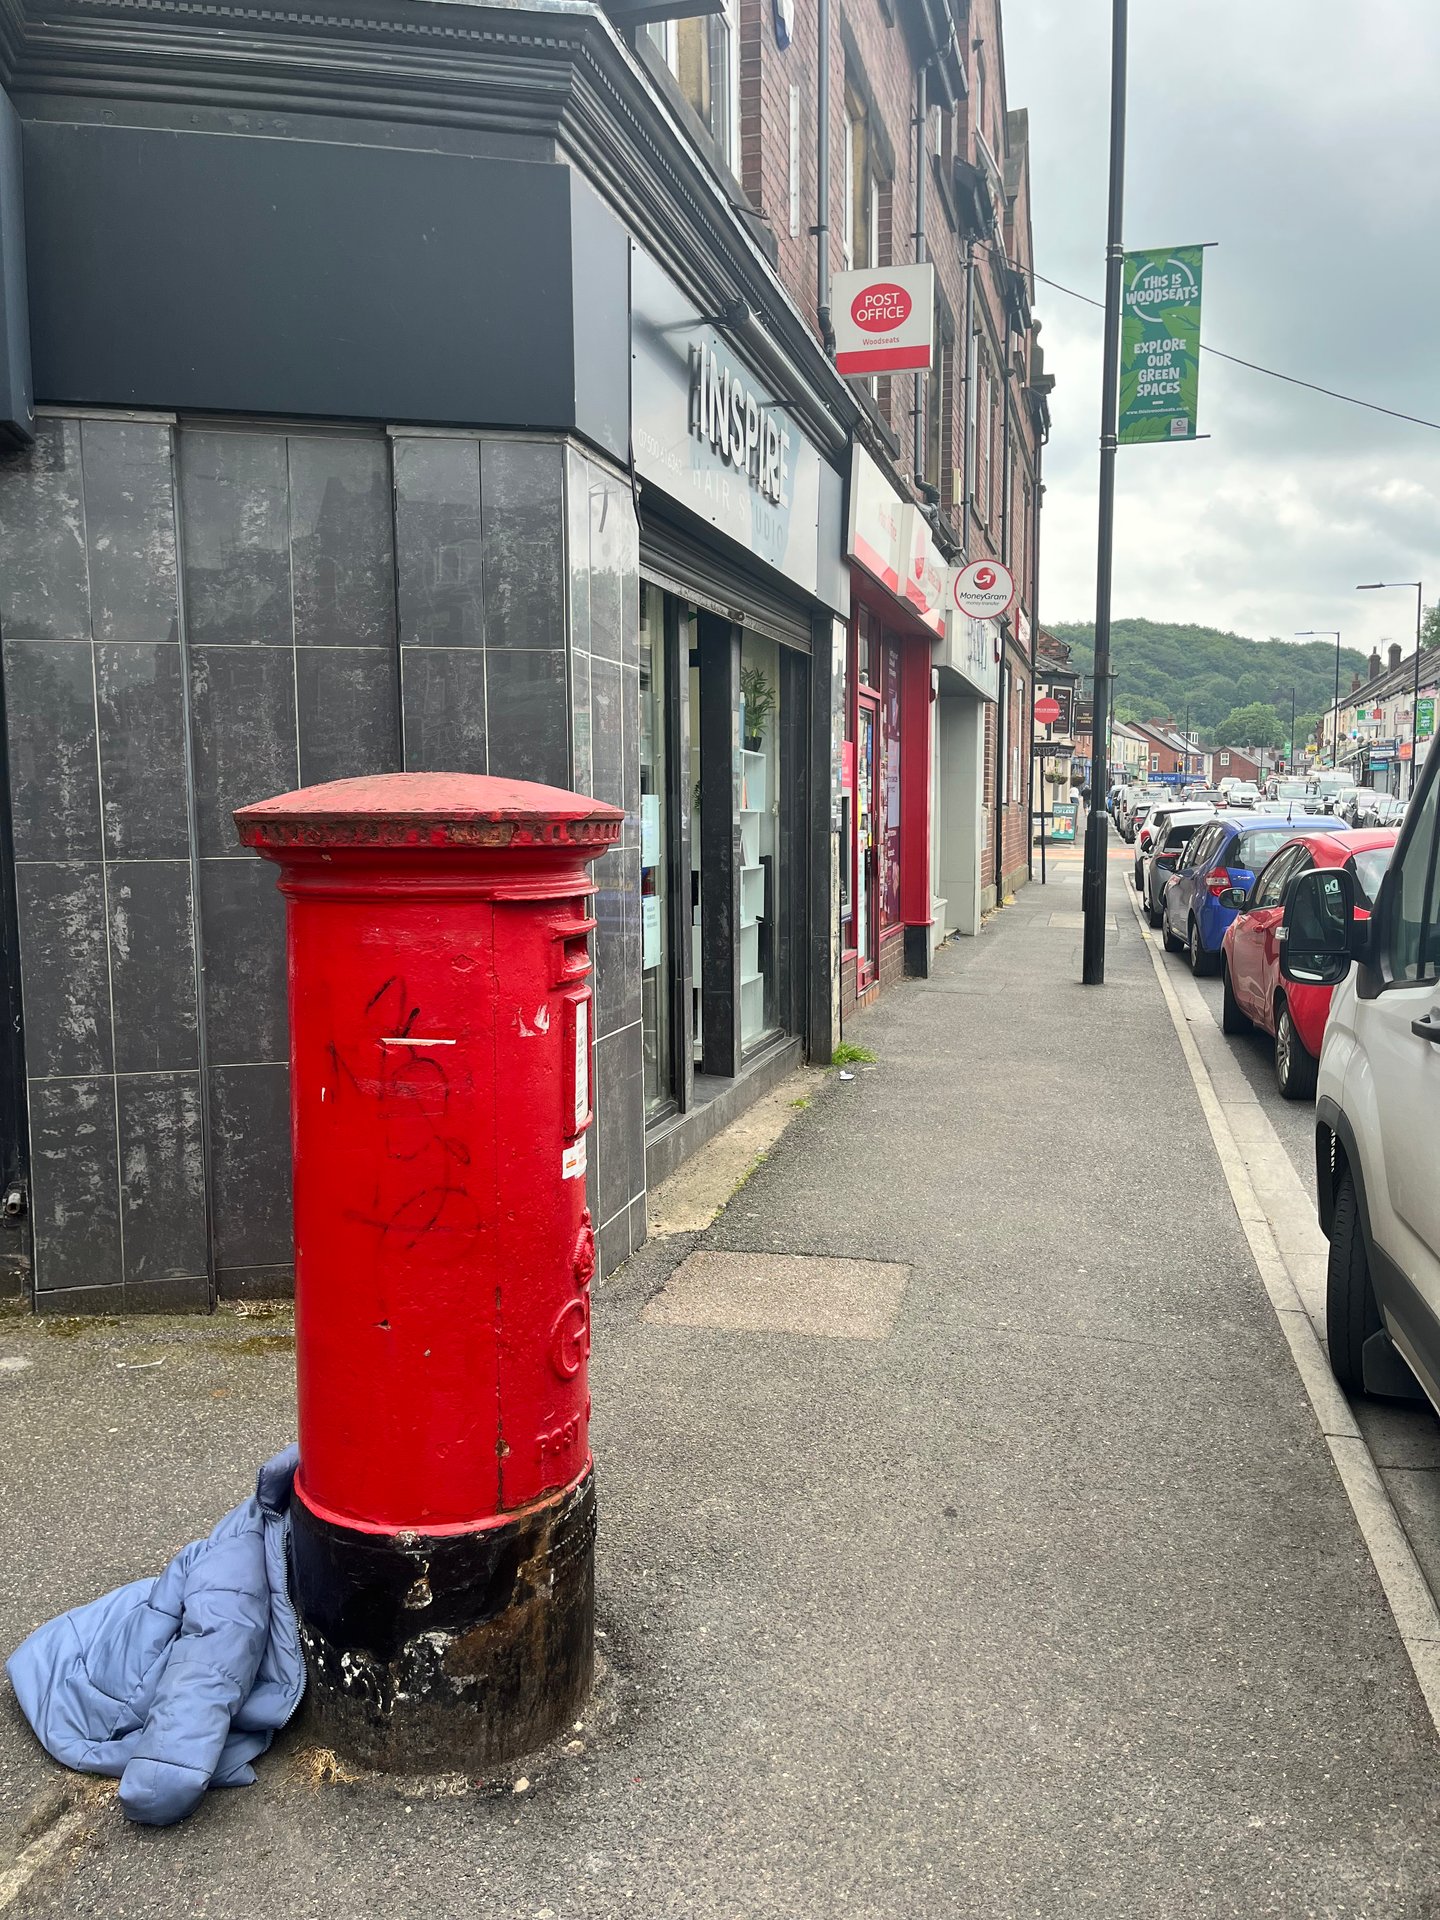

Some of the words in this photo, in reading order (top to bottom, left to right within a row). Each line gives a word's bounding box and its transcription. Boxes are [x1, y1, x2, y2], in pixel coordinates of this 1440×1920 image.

[1143, 275, 1168, 289] THIS
[1171, 273, 1182, 286] IS
[865, 292, 900, 307] POST
[1126, 285, 1199, 305] WOODSEATS
[856, 306, 904, 322] OFFICE
[862, 336, 900, 346] Woodseats
[1134, 338, 1187, 354] EXPLORE
[1147, 353, 1172, 367] OUR
[1138, 367, 1180, 383] GREEN
[1136, 381, 1181, 397] SPACES
[700, 341, 790, 509] INSPIRE
[692, 458, 730, 511] HAIR
[738, 493, 783, 550] SUDIO
[959, 592, 1008, 601] MoneyGram
[535, 1412, 581, 1463] POST
